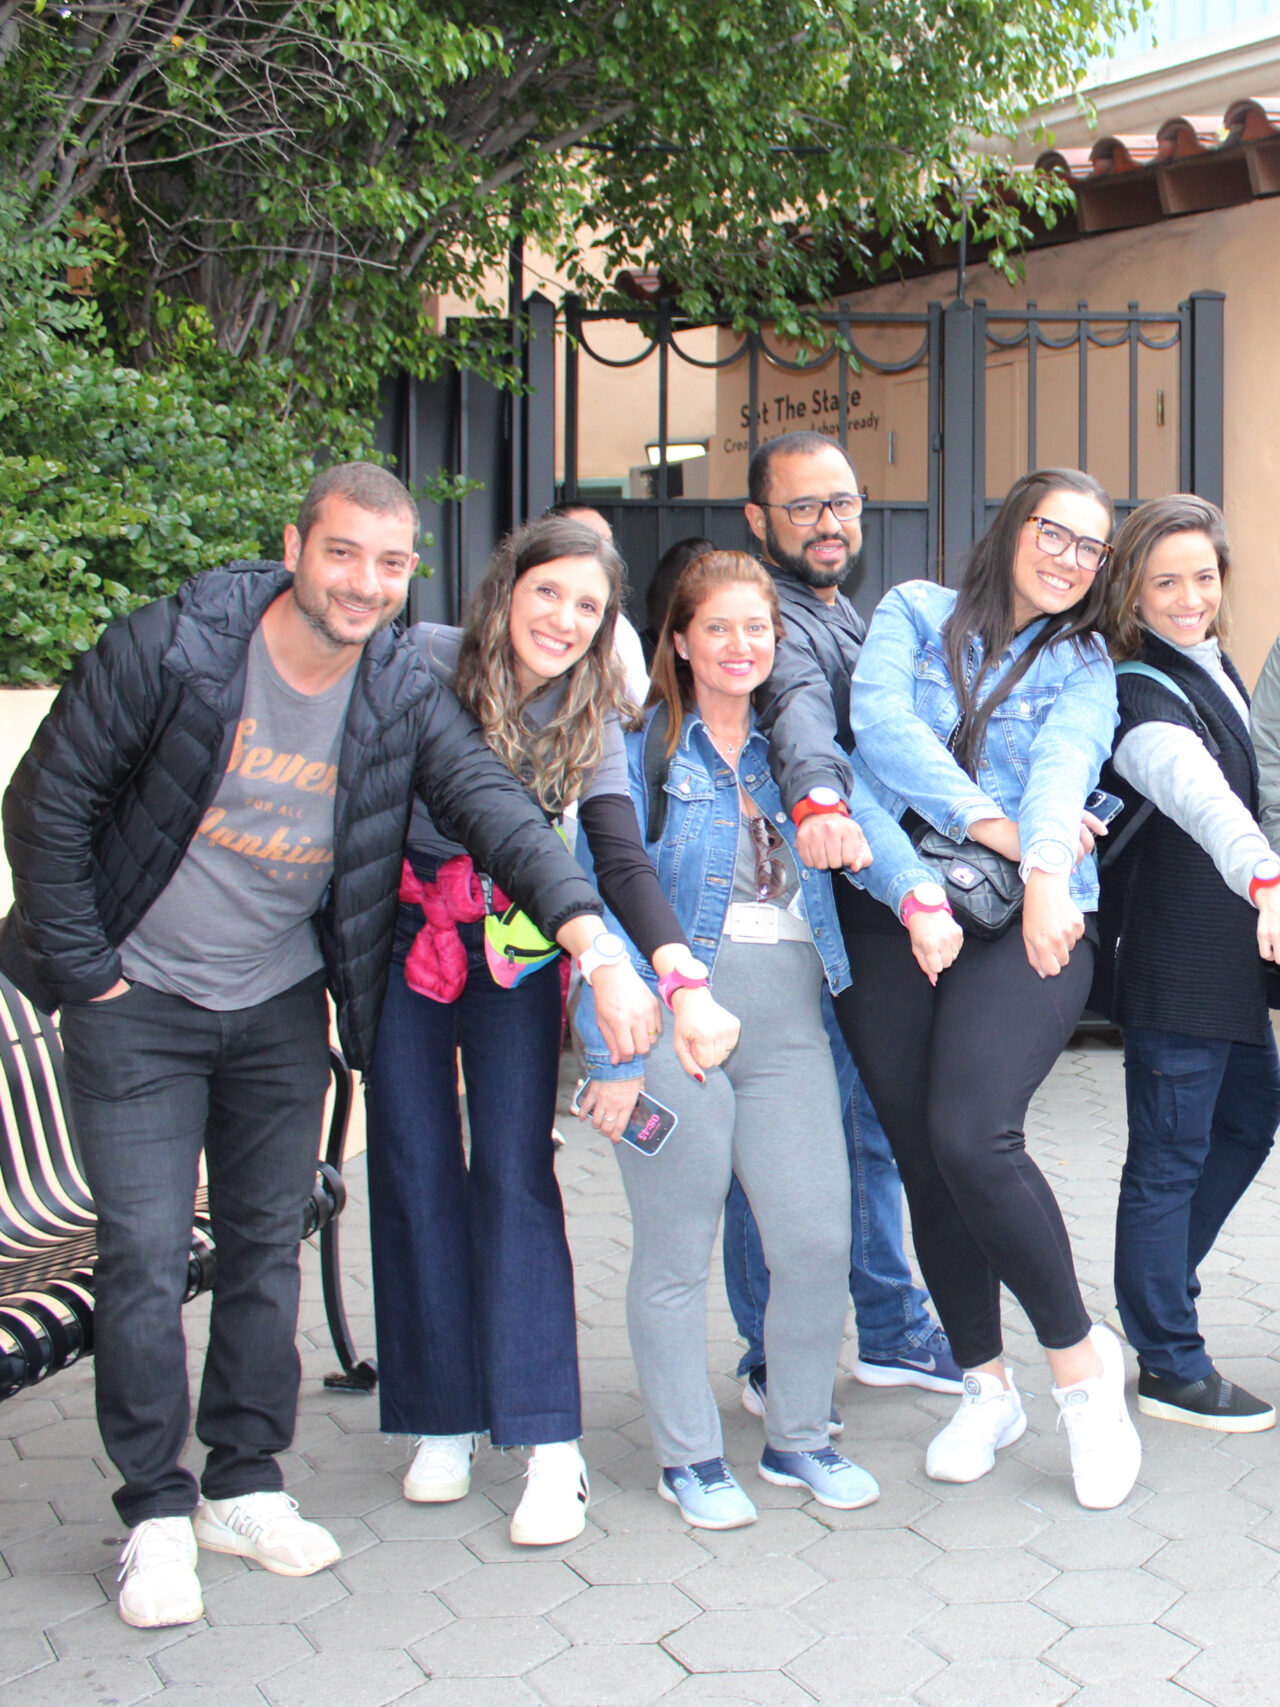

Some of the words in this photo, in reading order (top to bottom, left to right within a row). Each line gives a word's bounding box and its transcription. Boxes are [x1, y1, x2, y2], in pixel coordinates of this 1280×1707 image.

[740, 403, 769, 428] St
[774, 394, 806, 422] The
[812, 389, 861, 415] Stae
[245, 797, 274, 813] FOR
[277, 804, 303, 820] ALL
